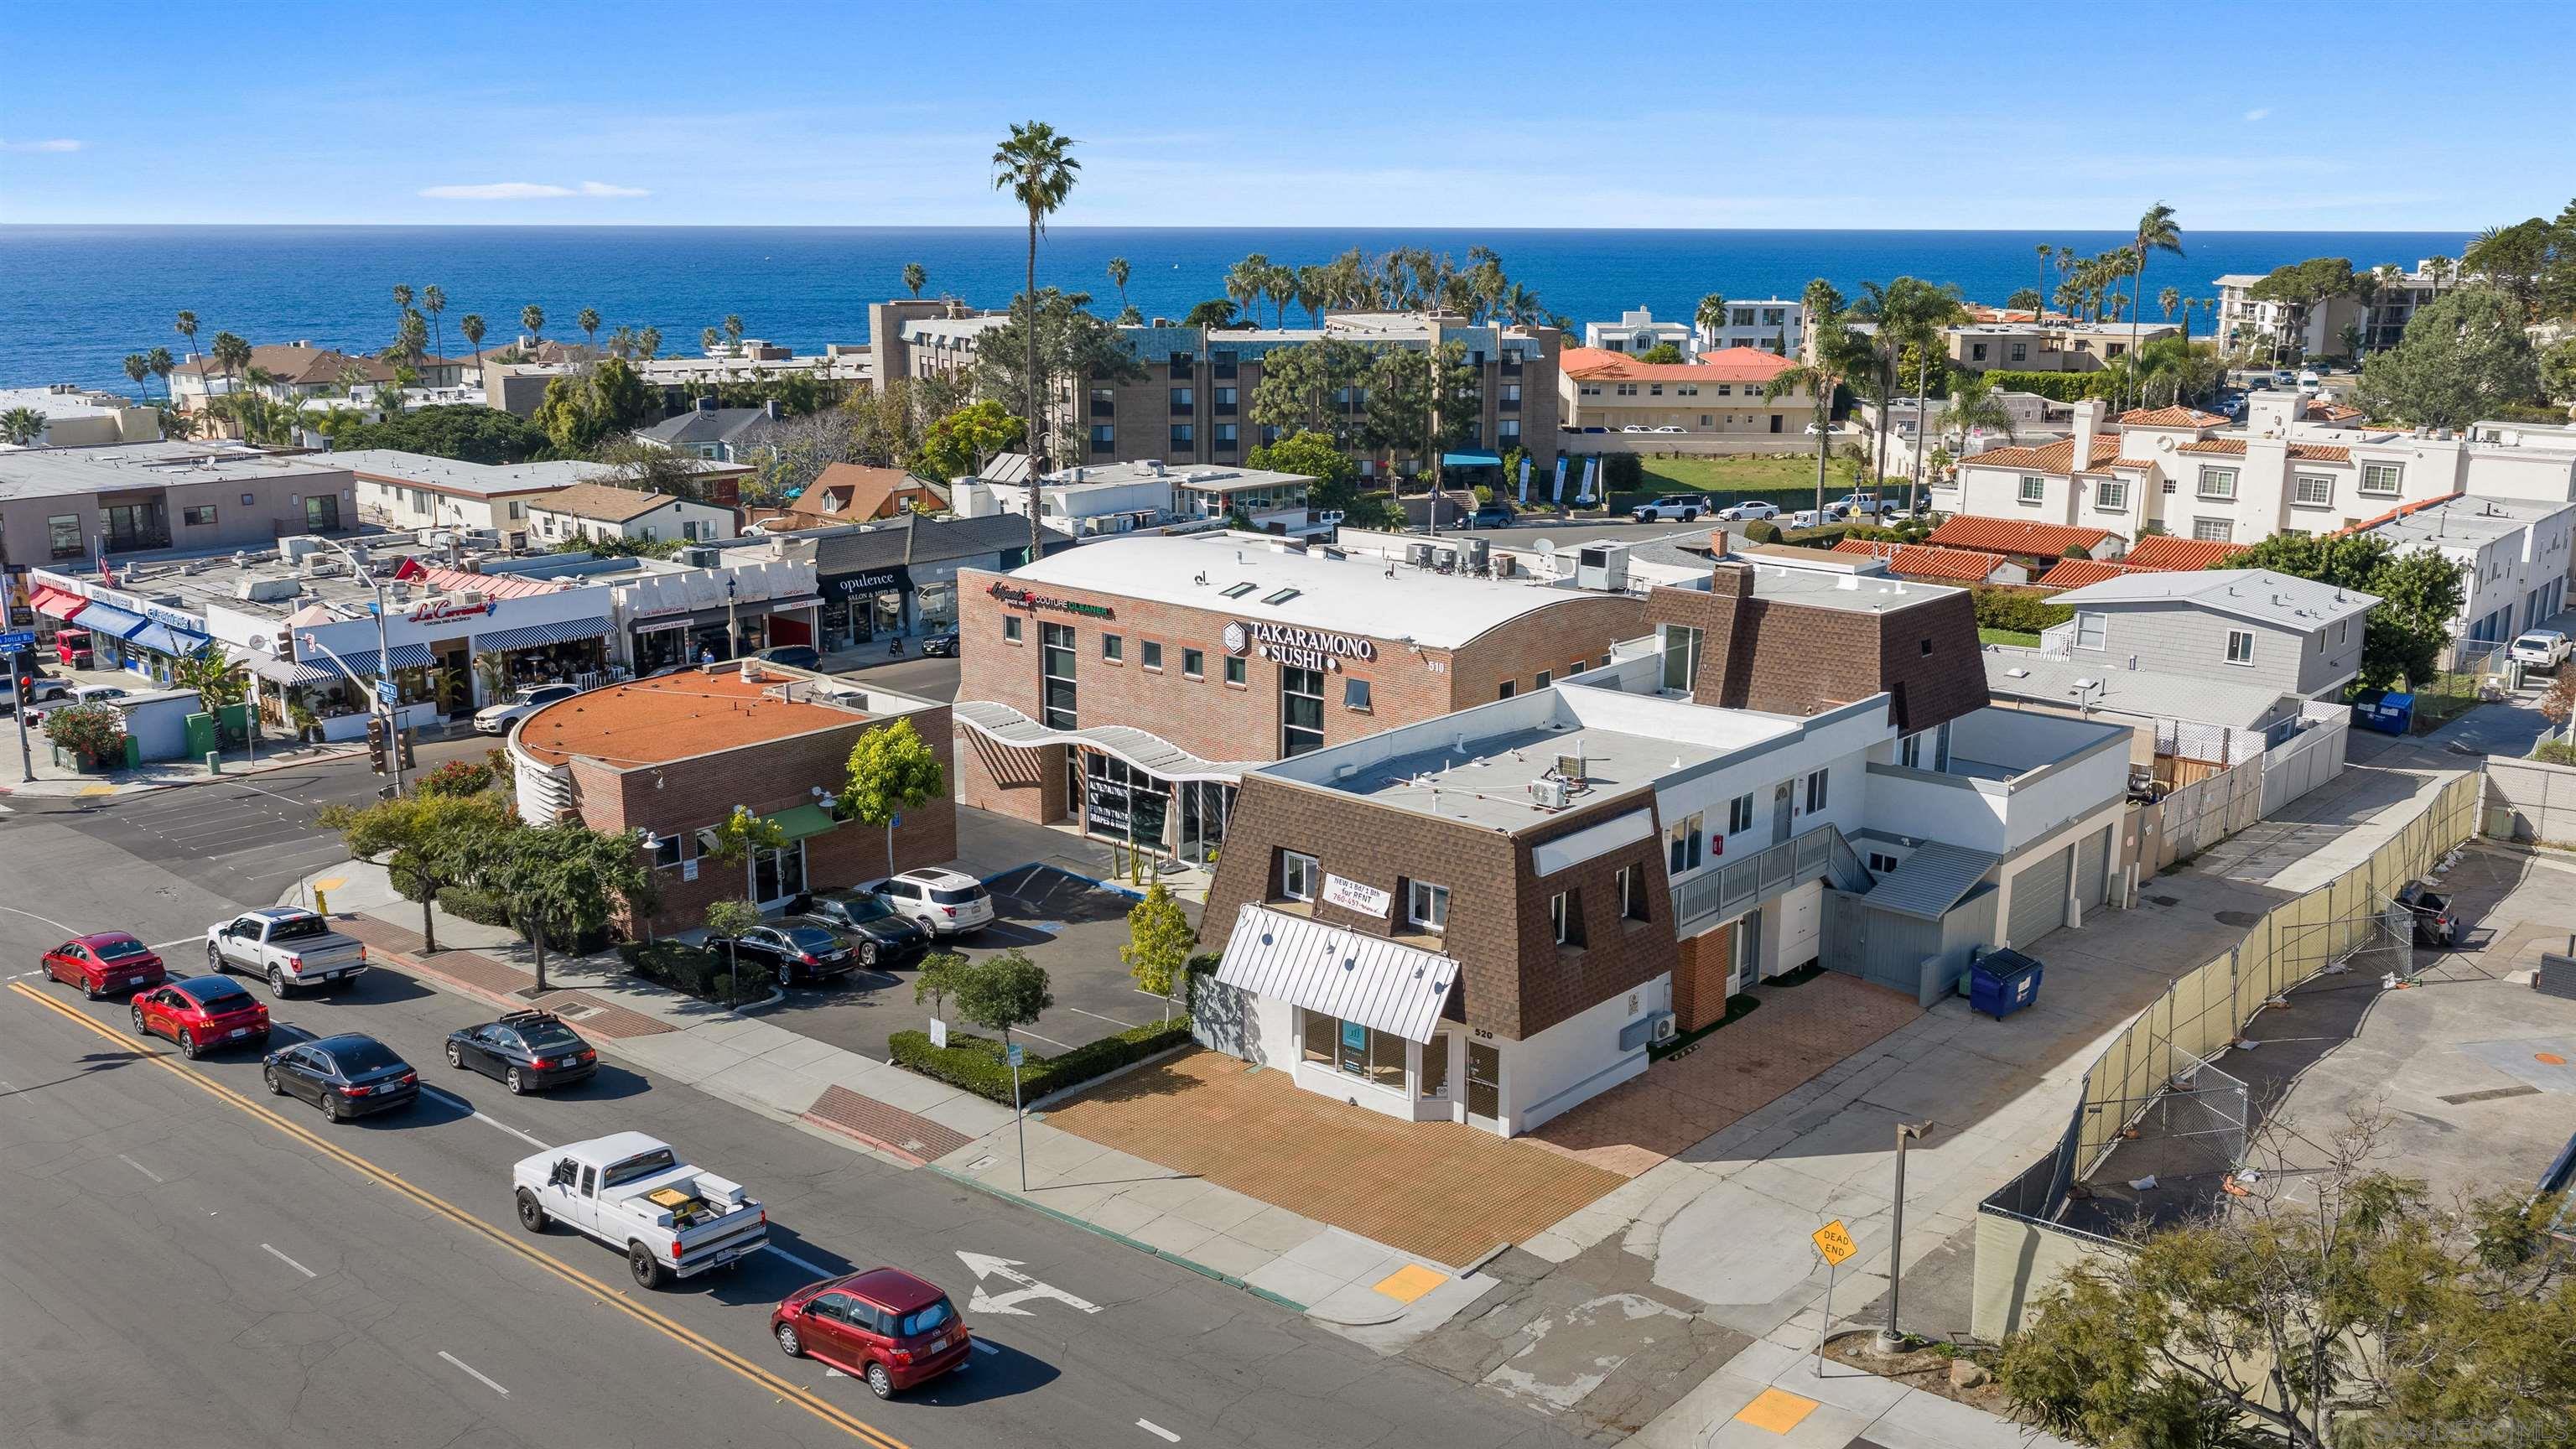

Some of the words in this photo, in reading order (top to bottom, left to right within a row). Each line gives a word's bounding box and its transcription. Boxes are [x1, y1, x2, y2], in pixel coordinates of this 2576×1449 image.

[840, 574, 895, 592] opulence
[847, 592, 868, 601] SALON
[1035, 596, 1067, 608] COUTURE
[409, 603, 434, 622] La
[1250, 621, 1372, 658] TAKARAMONO
[1271, 645, 1322, 671] SUSHI
[1428, 661, 1445, 673] 510
[1089, 781, 1129, 798] ALTERATIONS
[1090, 813, 1110, 826] DRAPES
[1334, 877, 1349, 887] NEW
[1342, 887, 1353, 897] for
[1353, 891, 1373, 903] RENT
[1475, 1028, 1493, 1040] 520
[1825, 1231, 1849, 1245] DEAD
[1826, 1244, 1845, 1257] END
